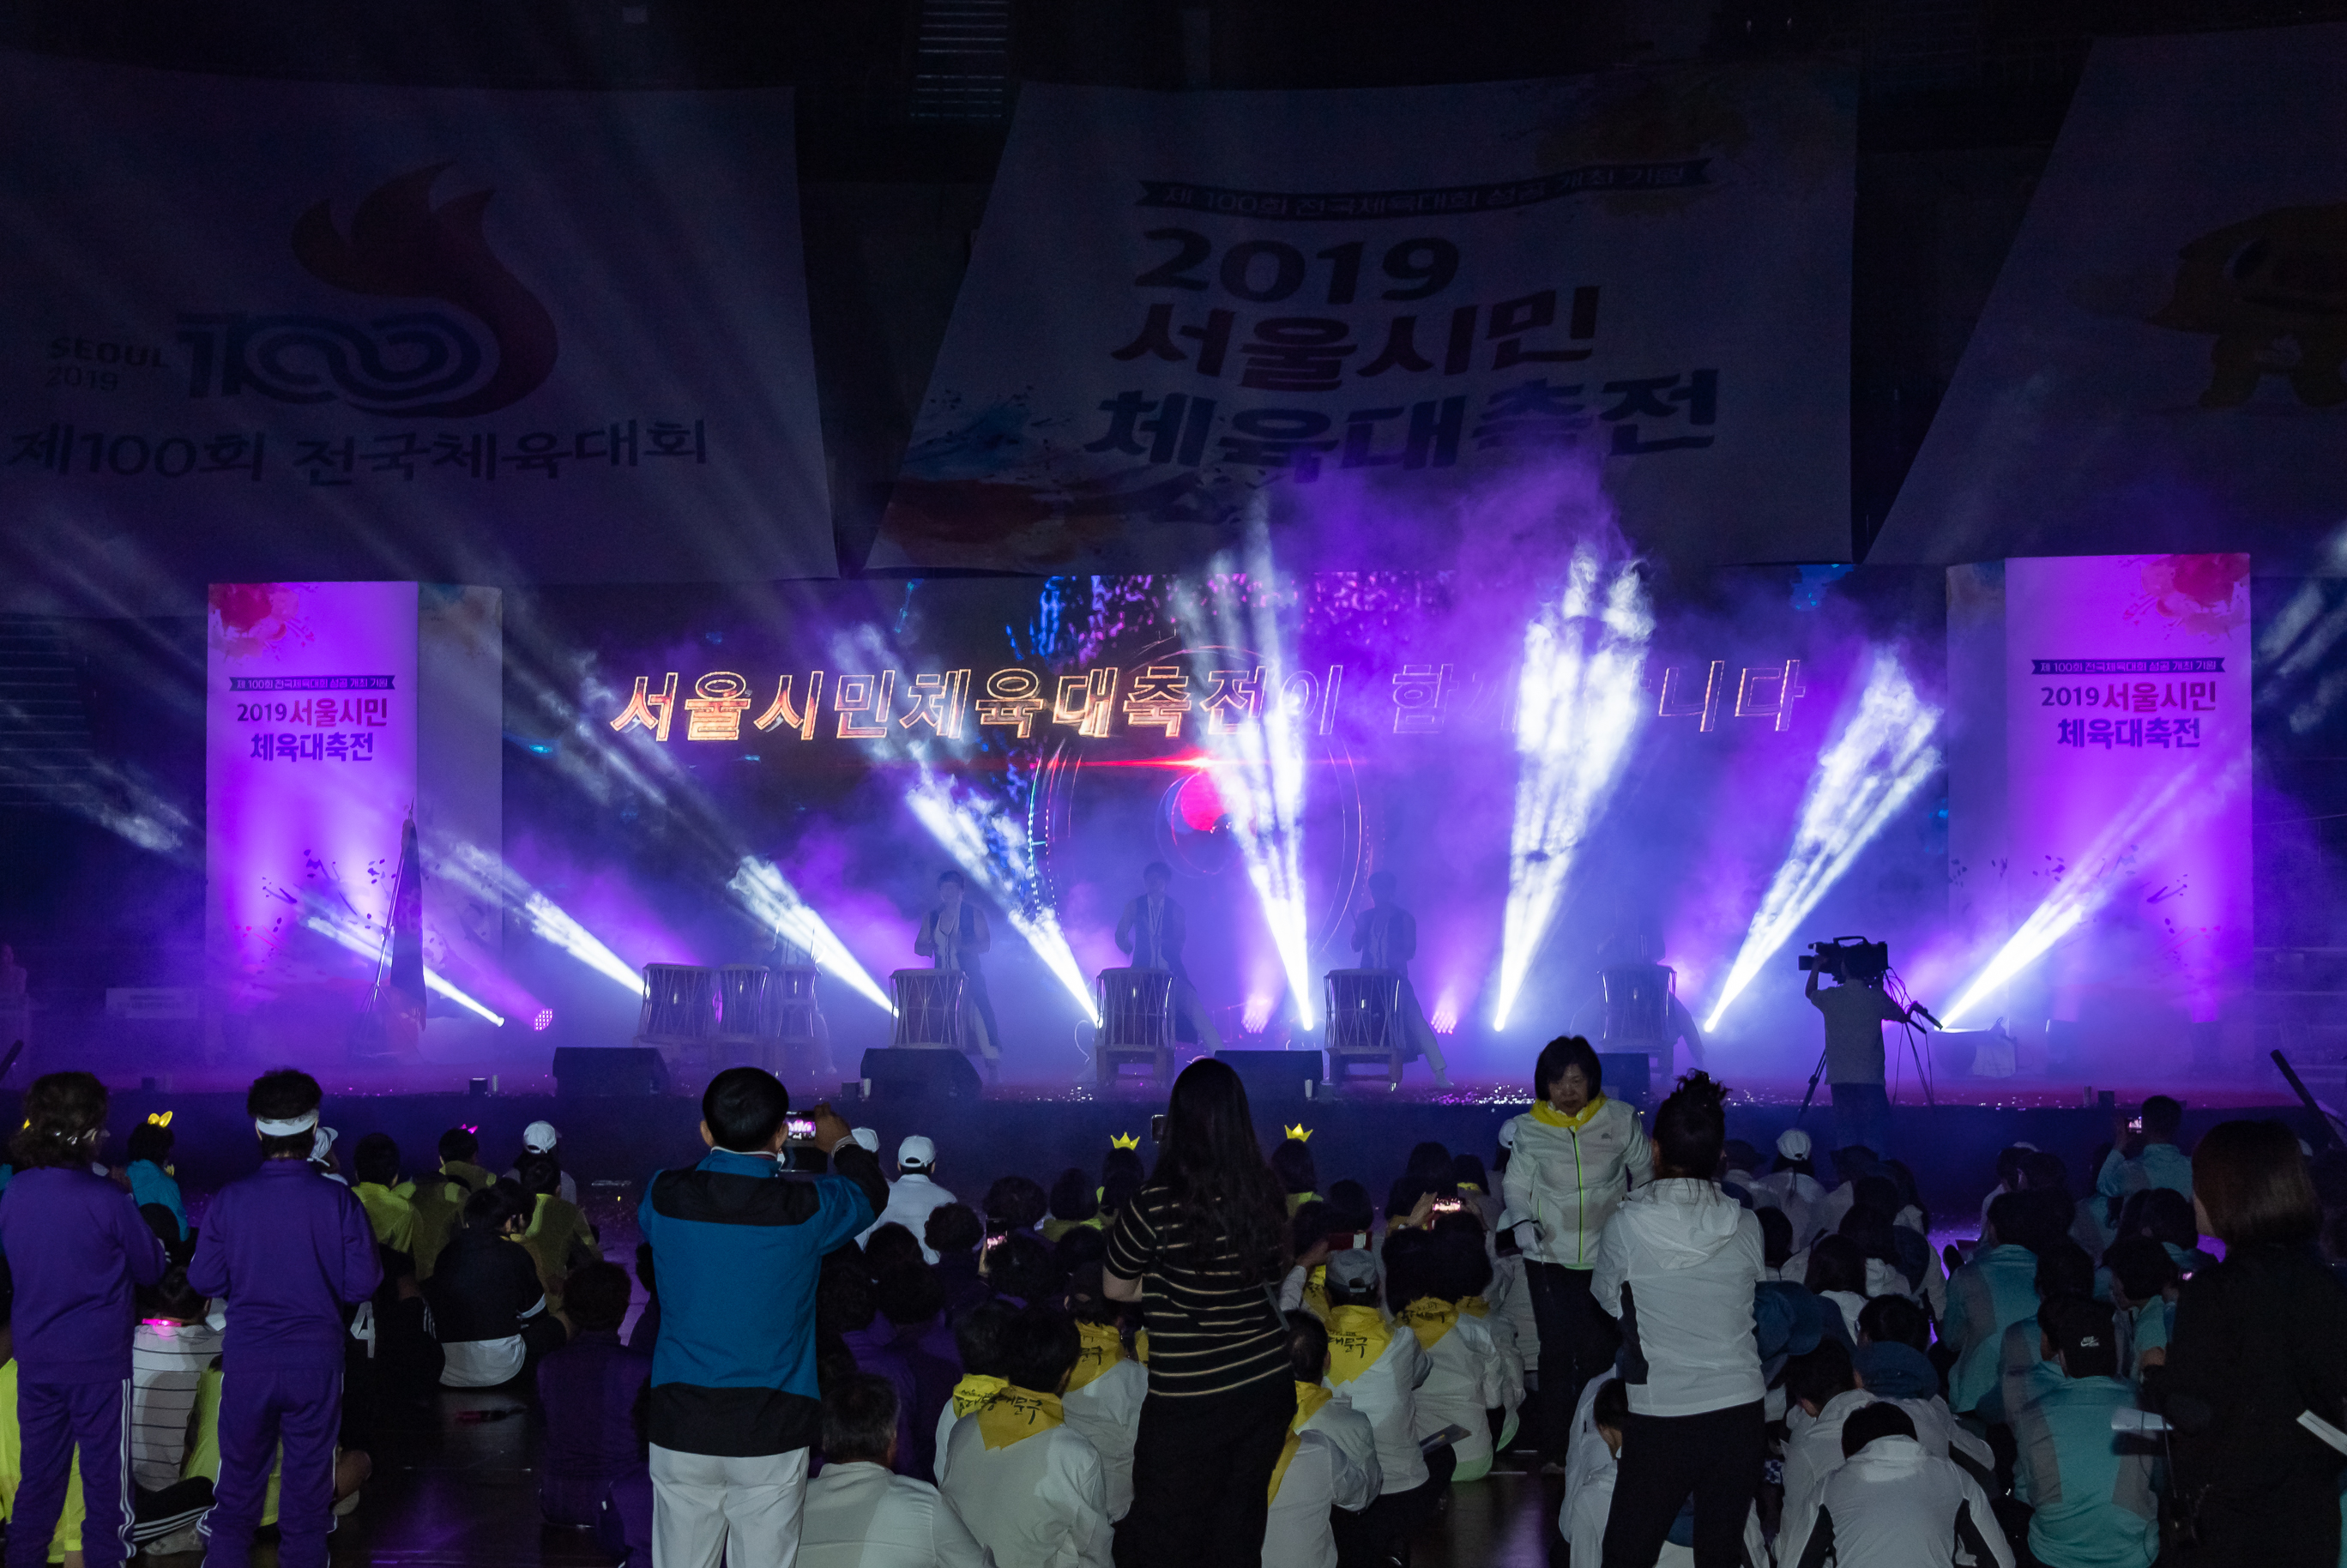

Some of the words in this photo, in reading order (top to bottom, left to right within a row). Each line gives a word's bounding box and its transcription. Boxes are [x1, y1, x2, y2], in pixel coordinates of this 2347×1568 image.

[1134, 226, 1460, 305] 2019
[45, 334, 170, 369] SEOUL
[1110, 286, 1602, 393] 서울시민
[45, 365, 120, 393] 2019
[7, 422, 264, 482] 제100회
[293, 419, 709, 486] 전국체육대회
[1083, 369, 1721, 484] 체육대축전
[610, 665, 1344, 741] 서울시민체육대축전이
[2056, 716, 2201, 750] 체육대축전
[250, 732, 374, 763] 체육대축전
